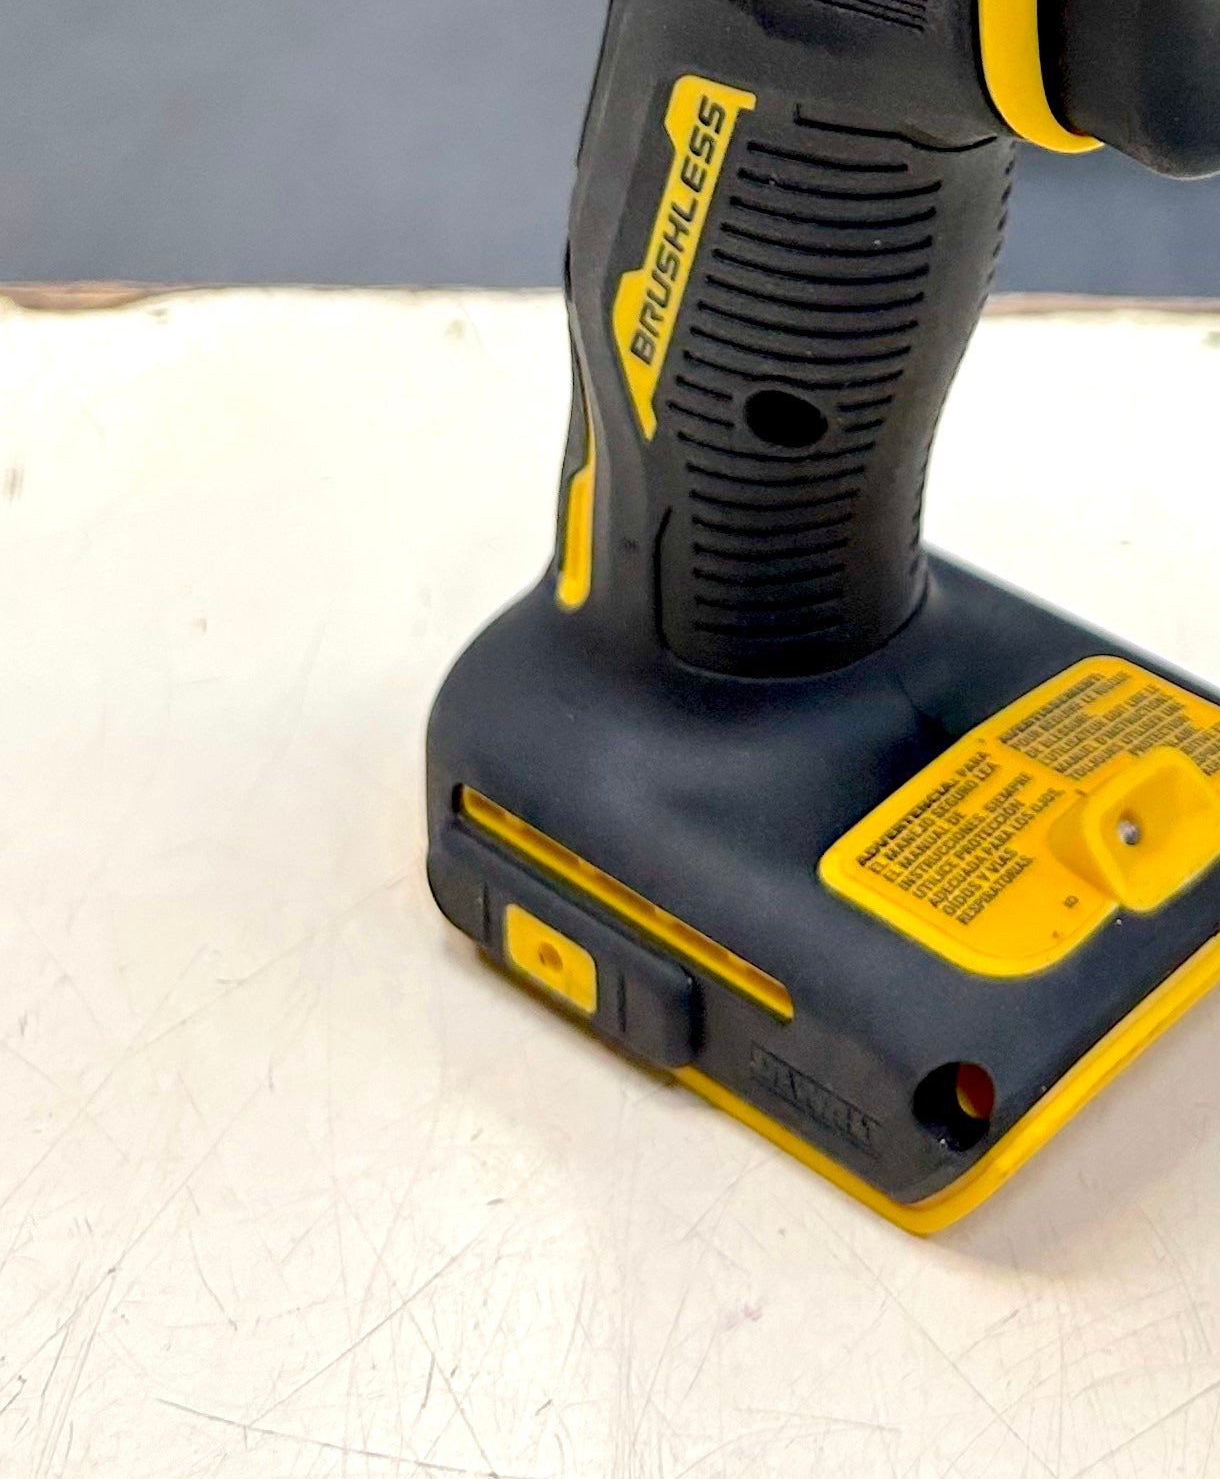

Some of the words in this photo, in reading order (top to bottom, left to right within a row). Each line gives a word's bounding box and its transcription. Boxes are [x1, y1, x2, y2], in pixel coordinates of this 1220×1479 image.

[629, 94, 727, 367] BRUSHLESS
[882, 817, 935, 860] MANEJO
[930, 779, 978, 817] SEGURO
[972, 761, 998, 780] LEA
[982, 772, 1032, 812] SIEMPRE
[897, 825, 949, 868] MANUAL
[945, 811, 964, 824] DE
[926, 854, 987, 905] ADECUADA
[982, 828, 1014, 855] PARA
[1009, 811, 1033, 829] LOS
[912, 859, 957, 897] UTILICE
[976, 872, 989, 881] Y
